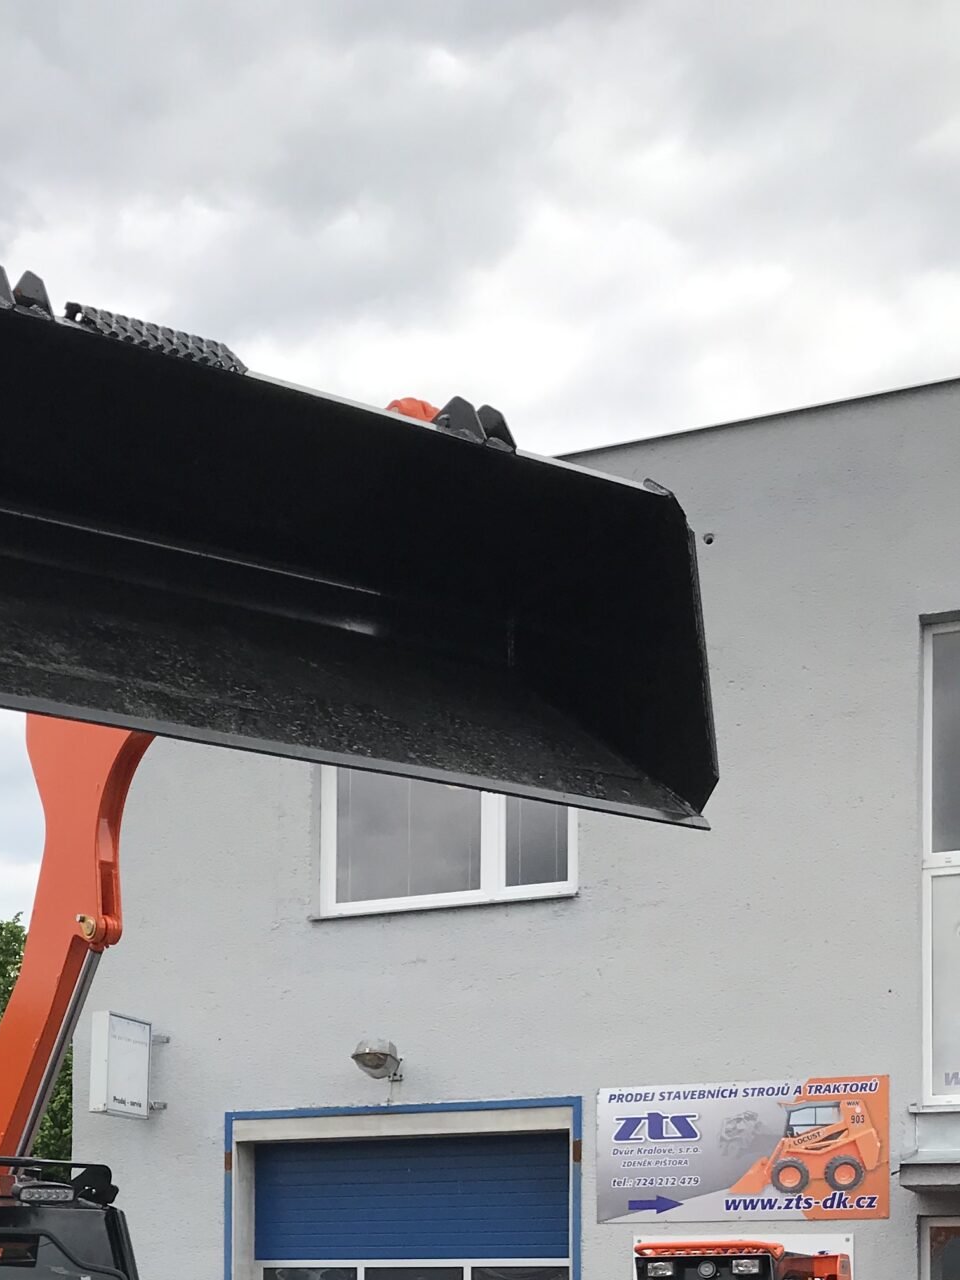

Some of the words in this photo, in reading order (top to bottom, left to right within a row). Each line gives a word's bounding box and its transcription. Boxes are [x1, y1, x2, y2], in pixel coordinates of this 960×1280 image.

[608, 1092, 655, 1104] PRODEJ
[658, 1087, 738, 1101] STAVEBNÍCH
[742, 1083, 790, 1098] STROJŮ
[793, 1085, 802, 1096] A
[807, 1079, 879, 1095] TRAKTORŮ
[851, 1114, 865, 1124] 903
[793, 1131, 822, 1146] LOCUST
[612, 1178, 632, 1187] tel.:
[636, 1178, 654, 1186] 724
[658, 1177, 676, 1186] 212
[680, 1176, 699, 1185] 479
[724, 1192, 877, 1211] www.zts-dk.cz
